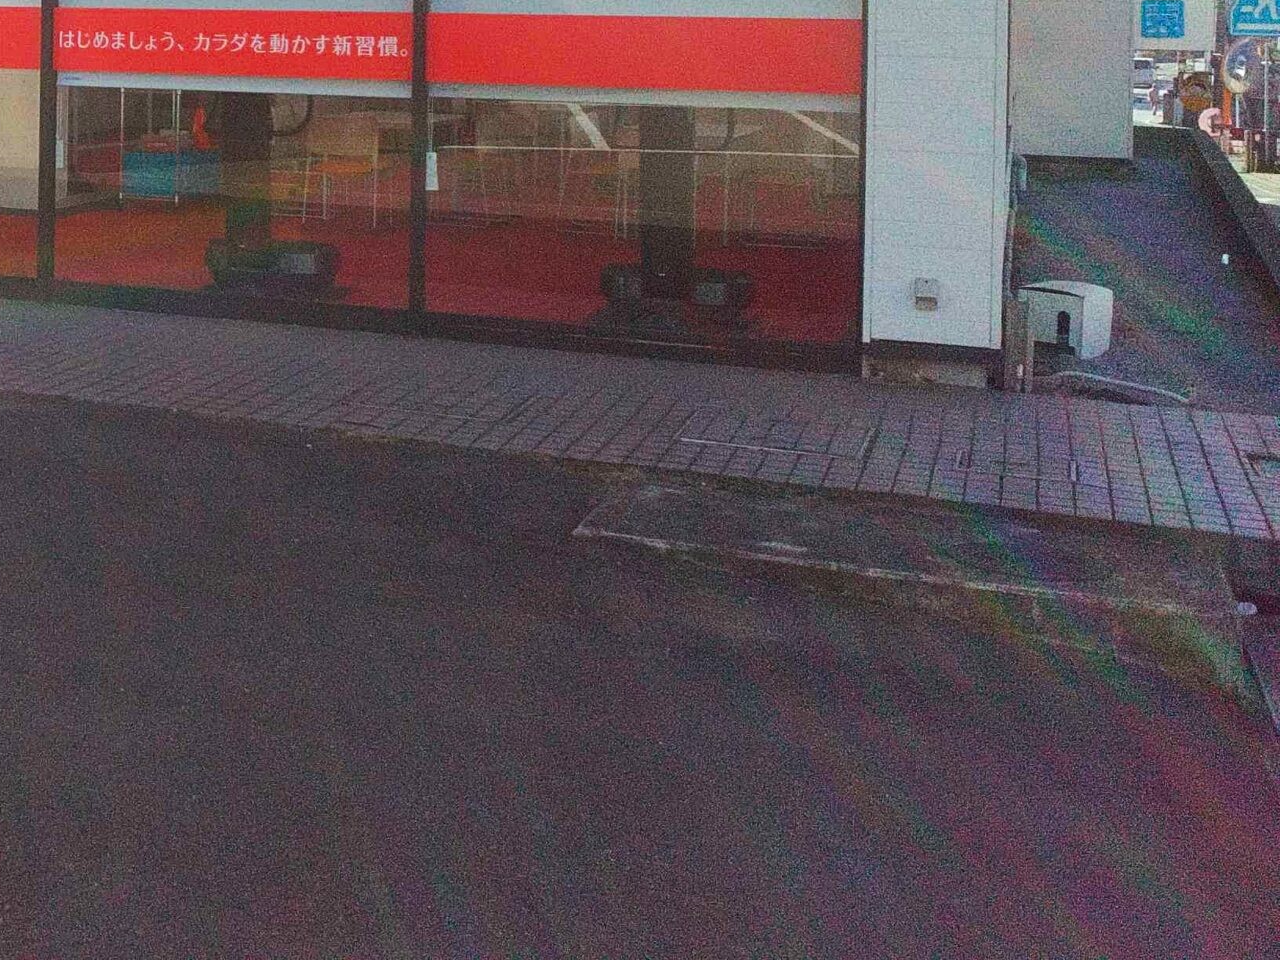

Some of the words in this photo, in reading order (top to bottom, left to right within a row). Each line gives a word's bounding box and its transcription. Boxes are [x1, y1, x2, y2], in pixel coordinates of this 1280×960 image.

[58, 30, 410, 57] はじめましょう、カラダを動かす新習慣。
